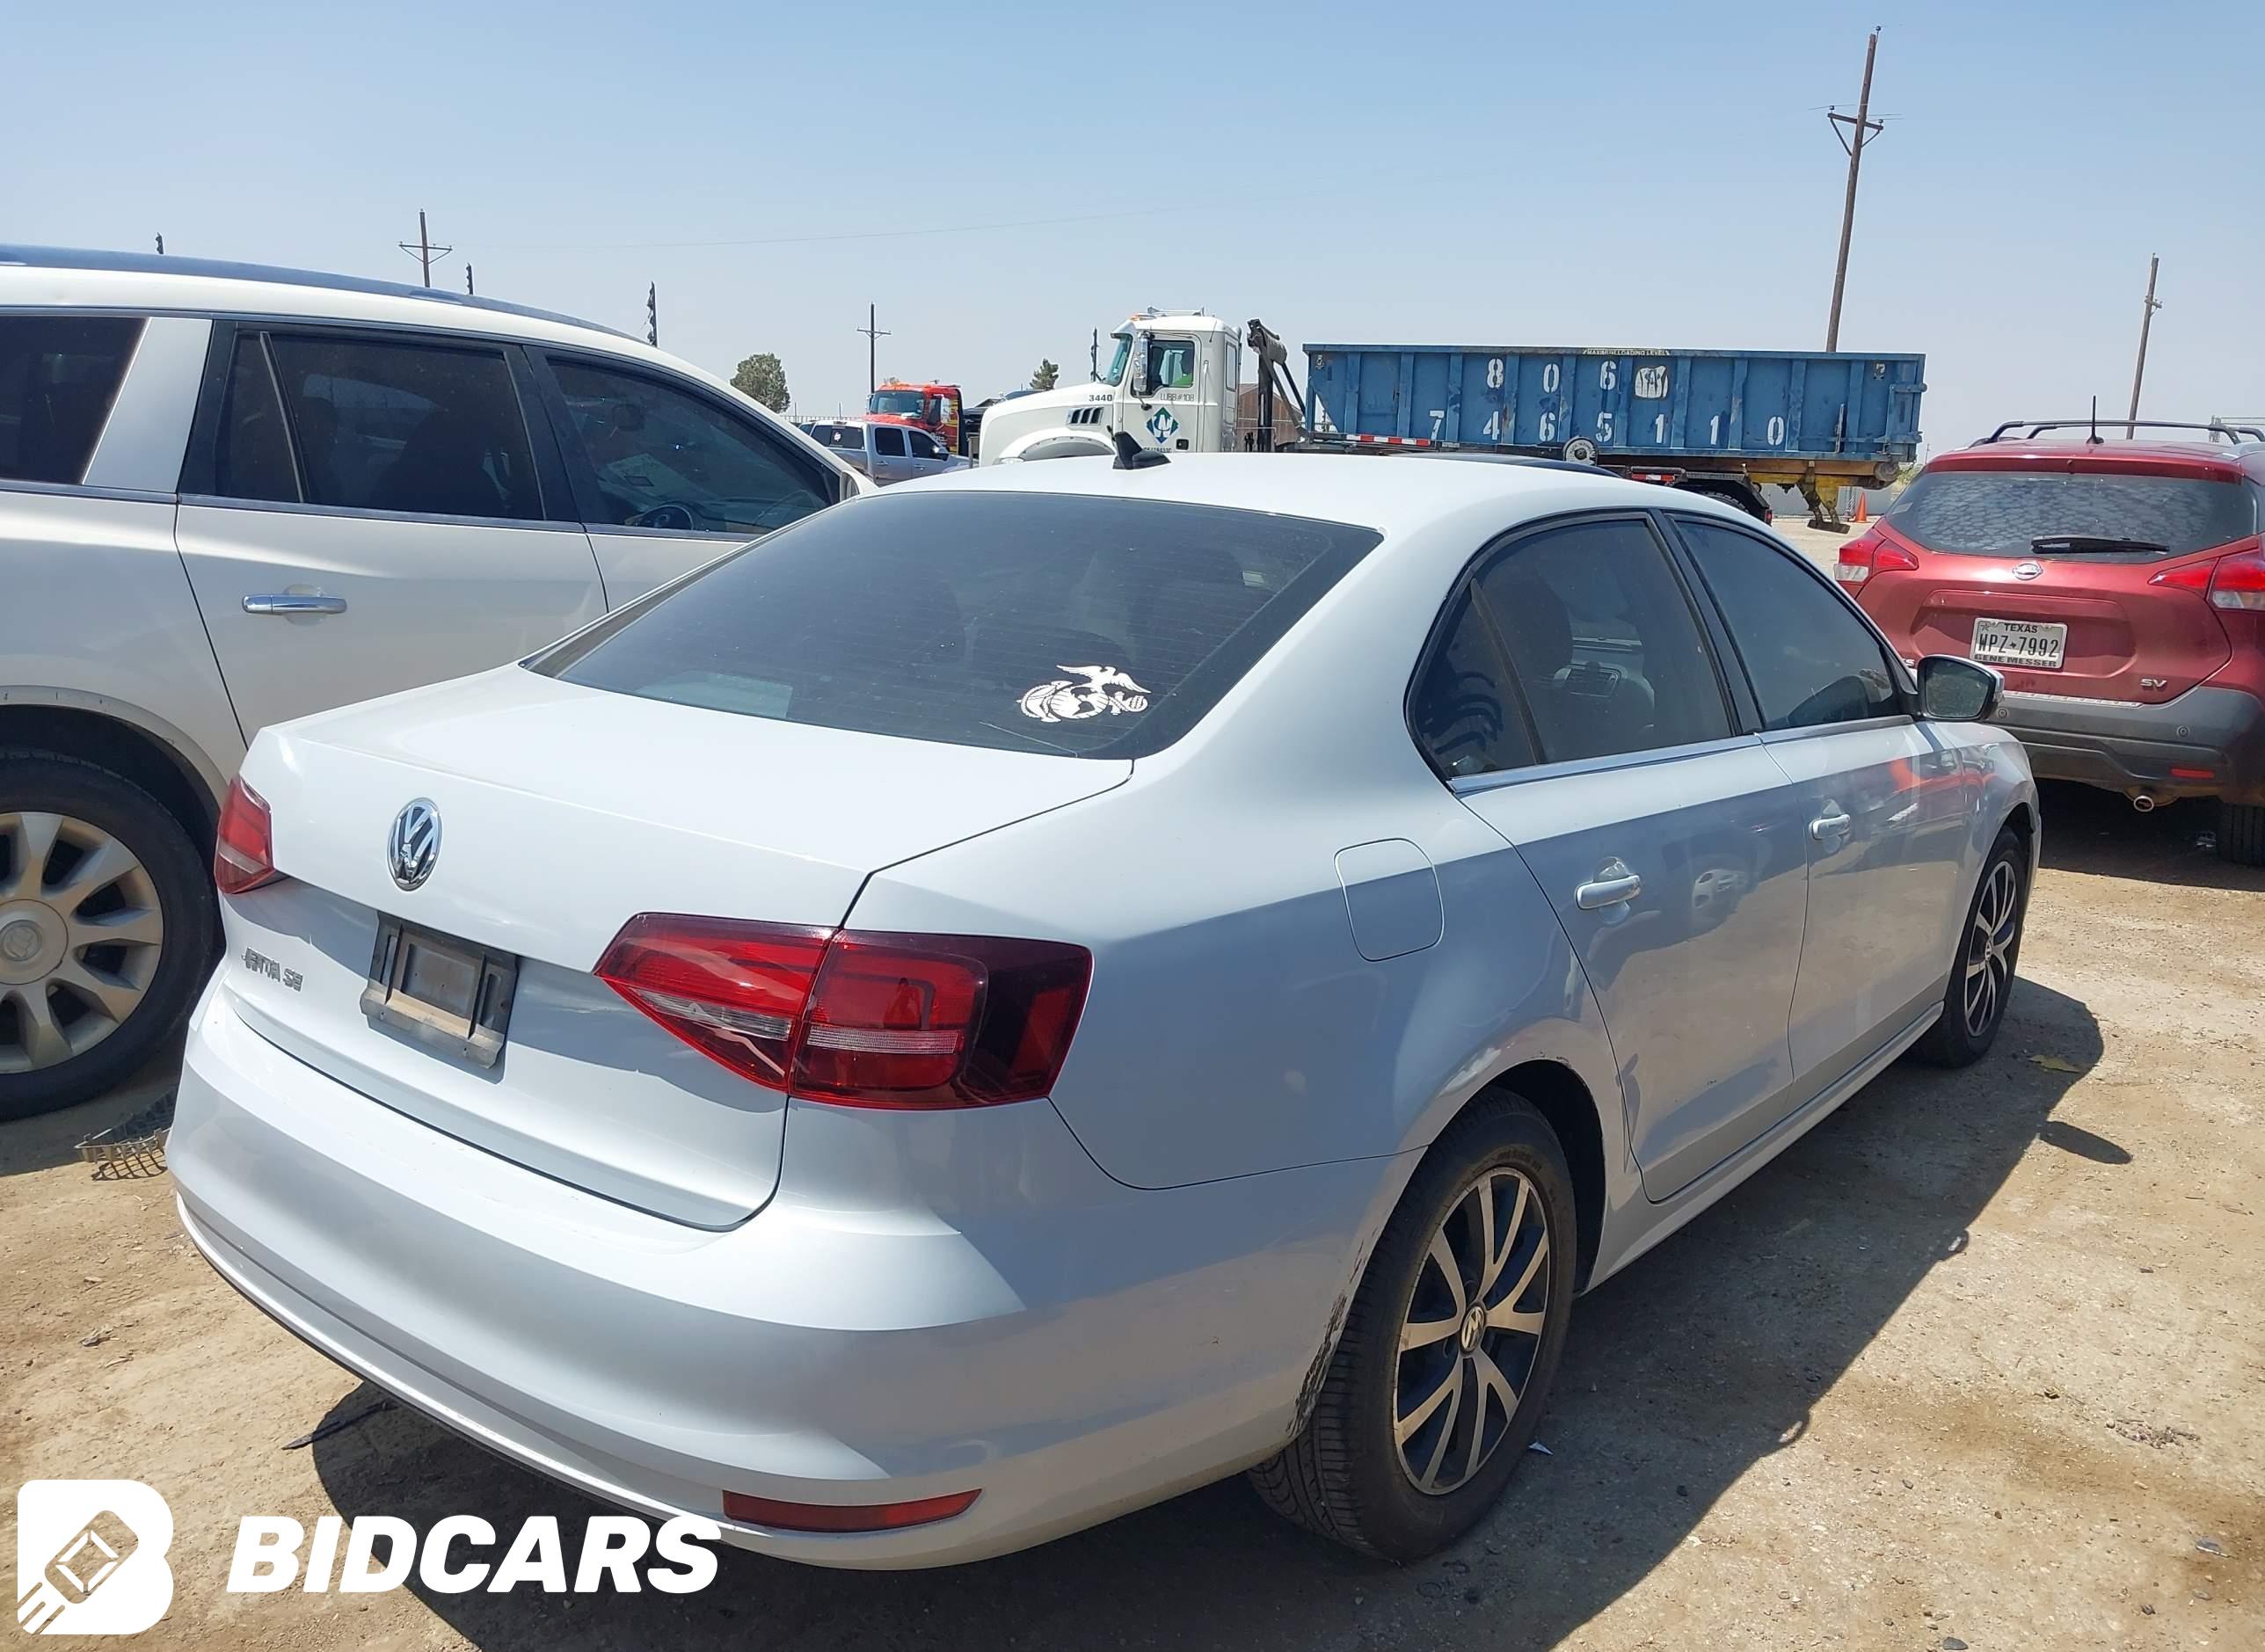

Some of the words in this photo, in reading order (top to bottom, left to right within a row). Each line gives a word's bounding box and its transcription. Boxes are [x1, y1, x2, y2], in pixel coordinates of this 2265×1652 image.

[2005, 622, 2038, 633] TEXAS
[1974, 654, 2005, 663] GENE
[2006, 657, 2057, 667] MESSER
[2140, 678, 2167, 688] SV
